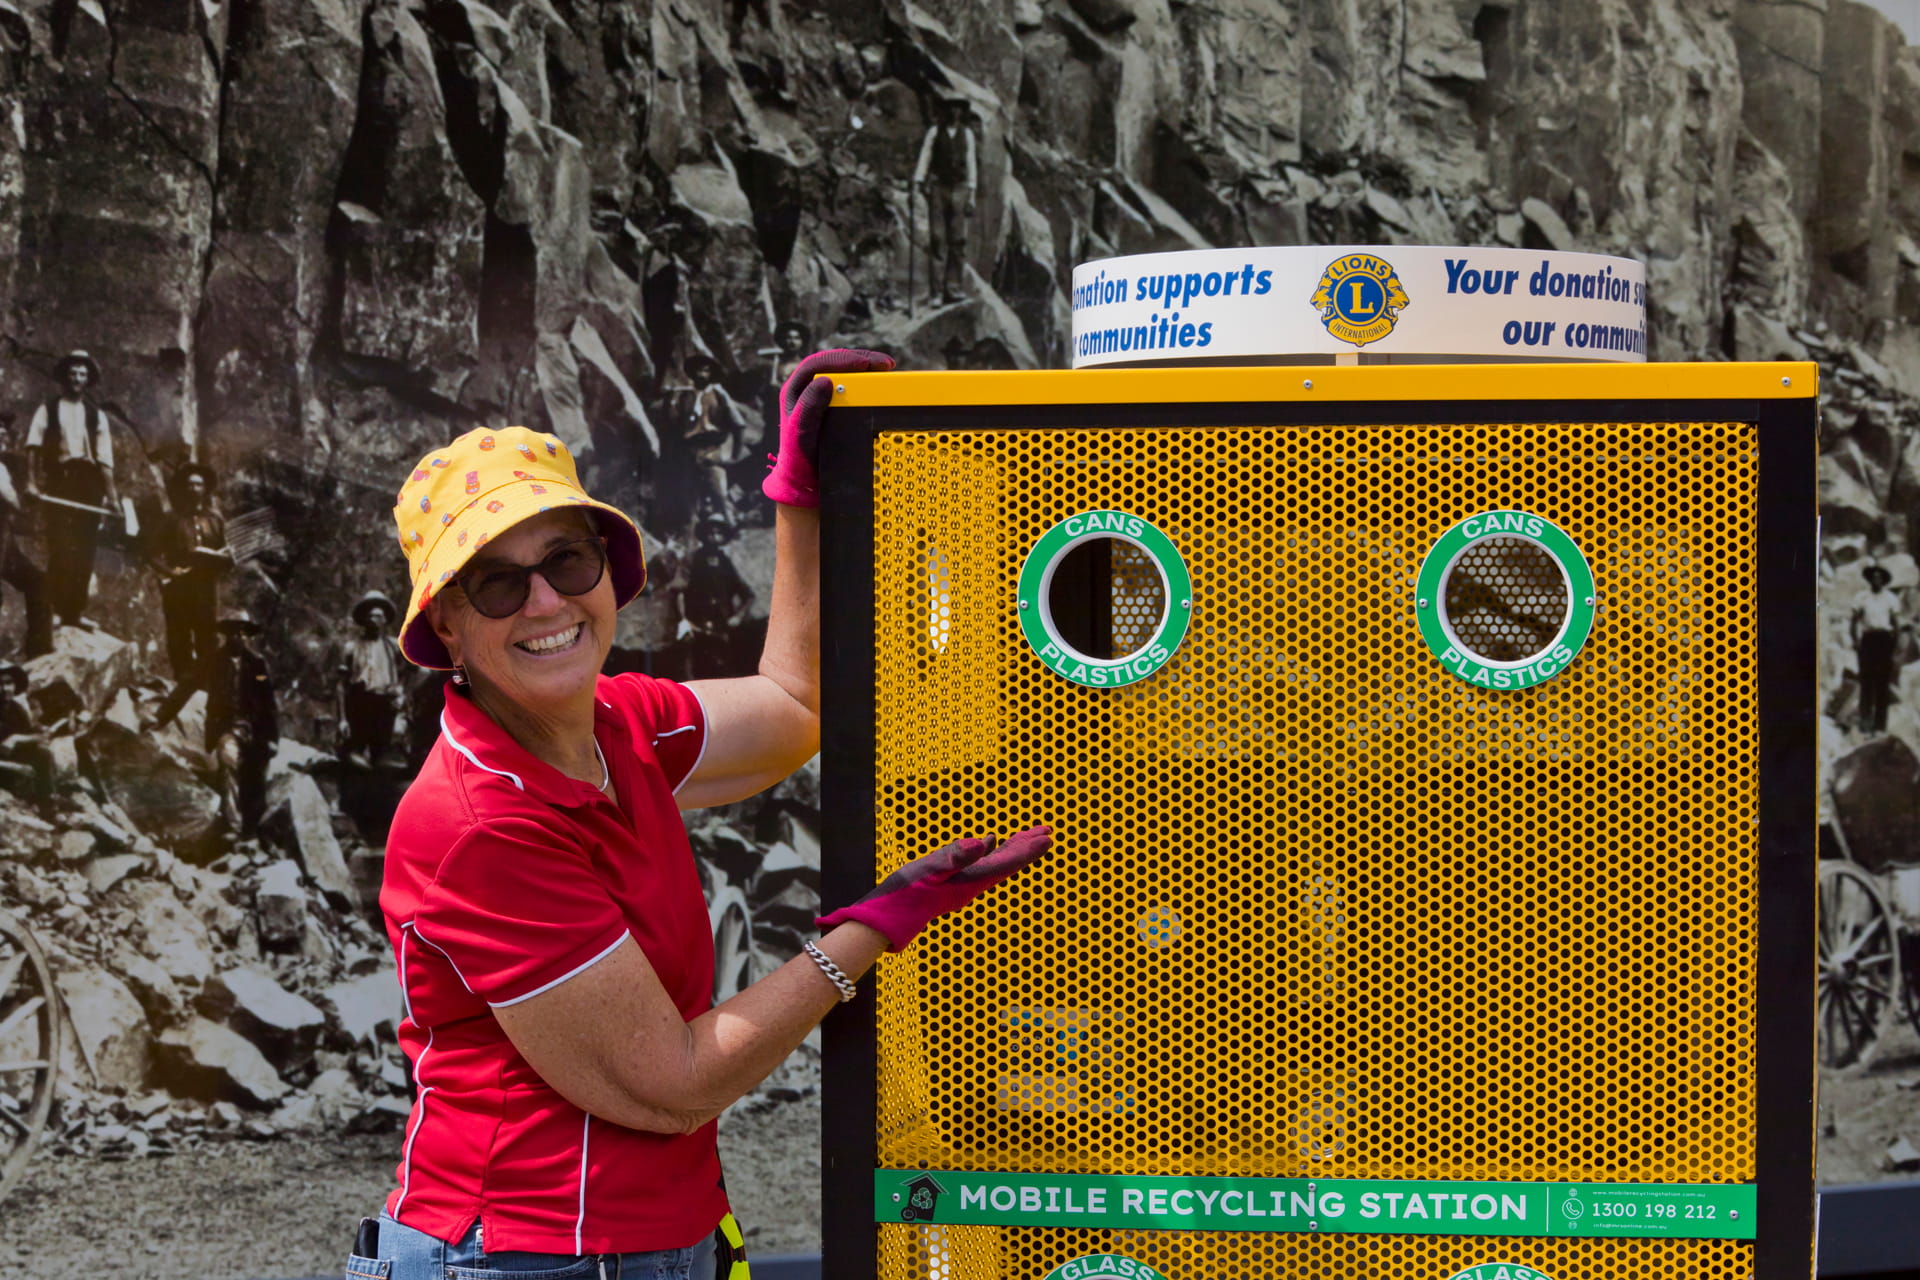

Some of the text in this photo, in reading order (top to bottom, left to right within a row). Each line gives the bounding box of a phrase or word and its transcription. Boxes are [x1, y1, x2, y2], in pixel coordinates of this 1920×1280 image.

[1332, 257, 1388, 277] LIONS
[1136, 264, 1273, 309] supports
[1444, 259, 1519, 295] Your
[1529, 260, 1630, 304] donation
[1349, 282, 1375, 313] L
[1079, 312, 1213, 357] communities
[1332, 322, 1388, 340] INTERNATIONAL
[1502, 320, 1555, 346] our
[1064, 513, 1145, 538] CANS
[1462, 513, 1545, 539] CANS
[1040, 642, 1169, 685] PLASTICS
[1439, 643, 1573, 688] PLASTICS
[960, 1184, 1527, 1221] MOBILE RECYCLING STATION
[1592, 1202, 1716, 1219] 1300 198 212
[1061, 1256, 1155, 1280] GLASS
